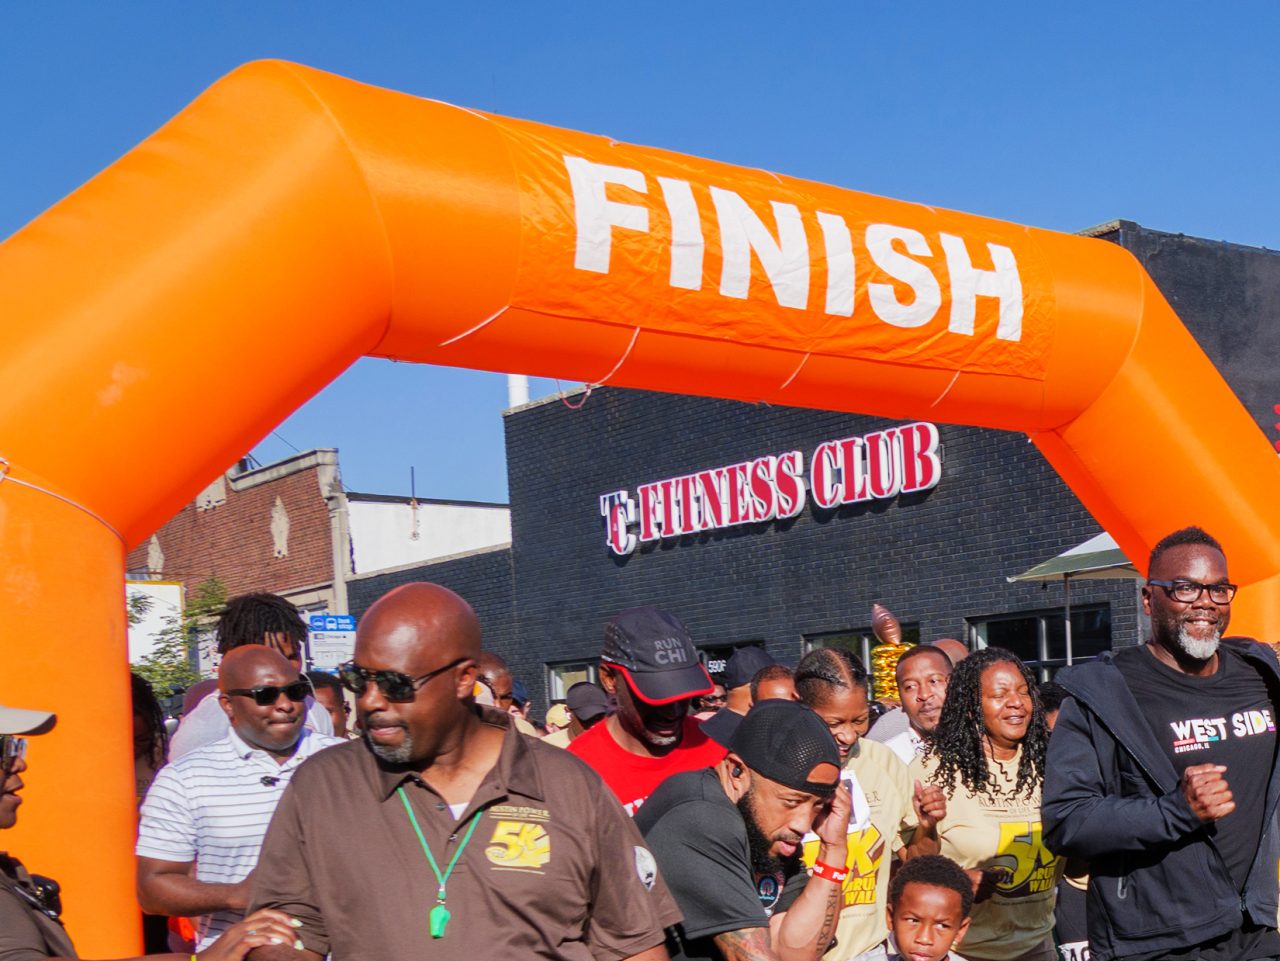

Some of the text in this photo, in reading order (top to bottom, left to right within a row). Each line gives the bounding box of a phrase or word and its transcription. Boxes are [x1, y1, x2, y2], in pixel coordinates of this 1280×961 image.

[563, 155, 1024, 342] FINISH
[637, 451, 806, 541] FITNESS
[811, 421, 942, 509] CLUB
[654, 637, 683, 651] RUN
[655, 648, 688, 665] CHI
[1170, 709, 1275, 742] WEST SIDE
[485, 820, 549, 866] 5K
